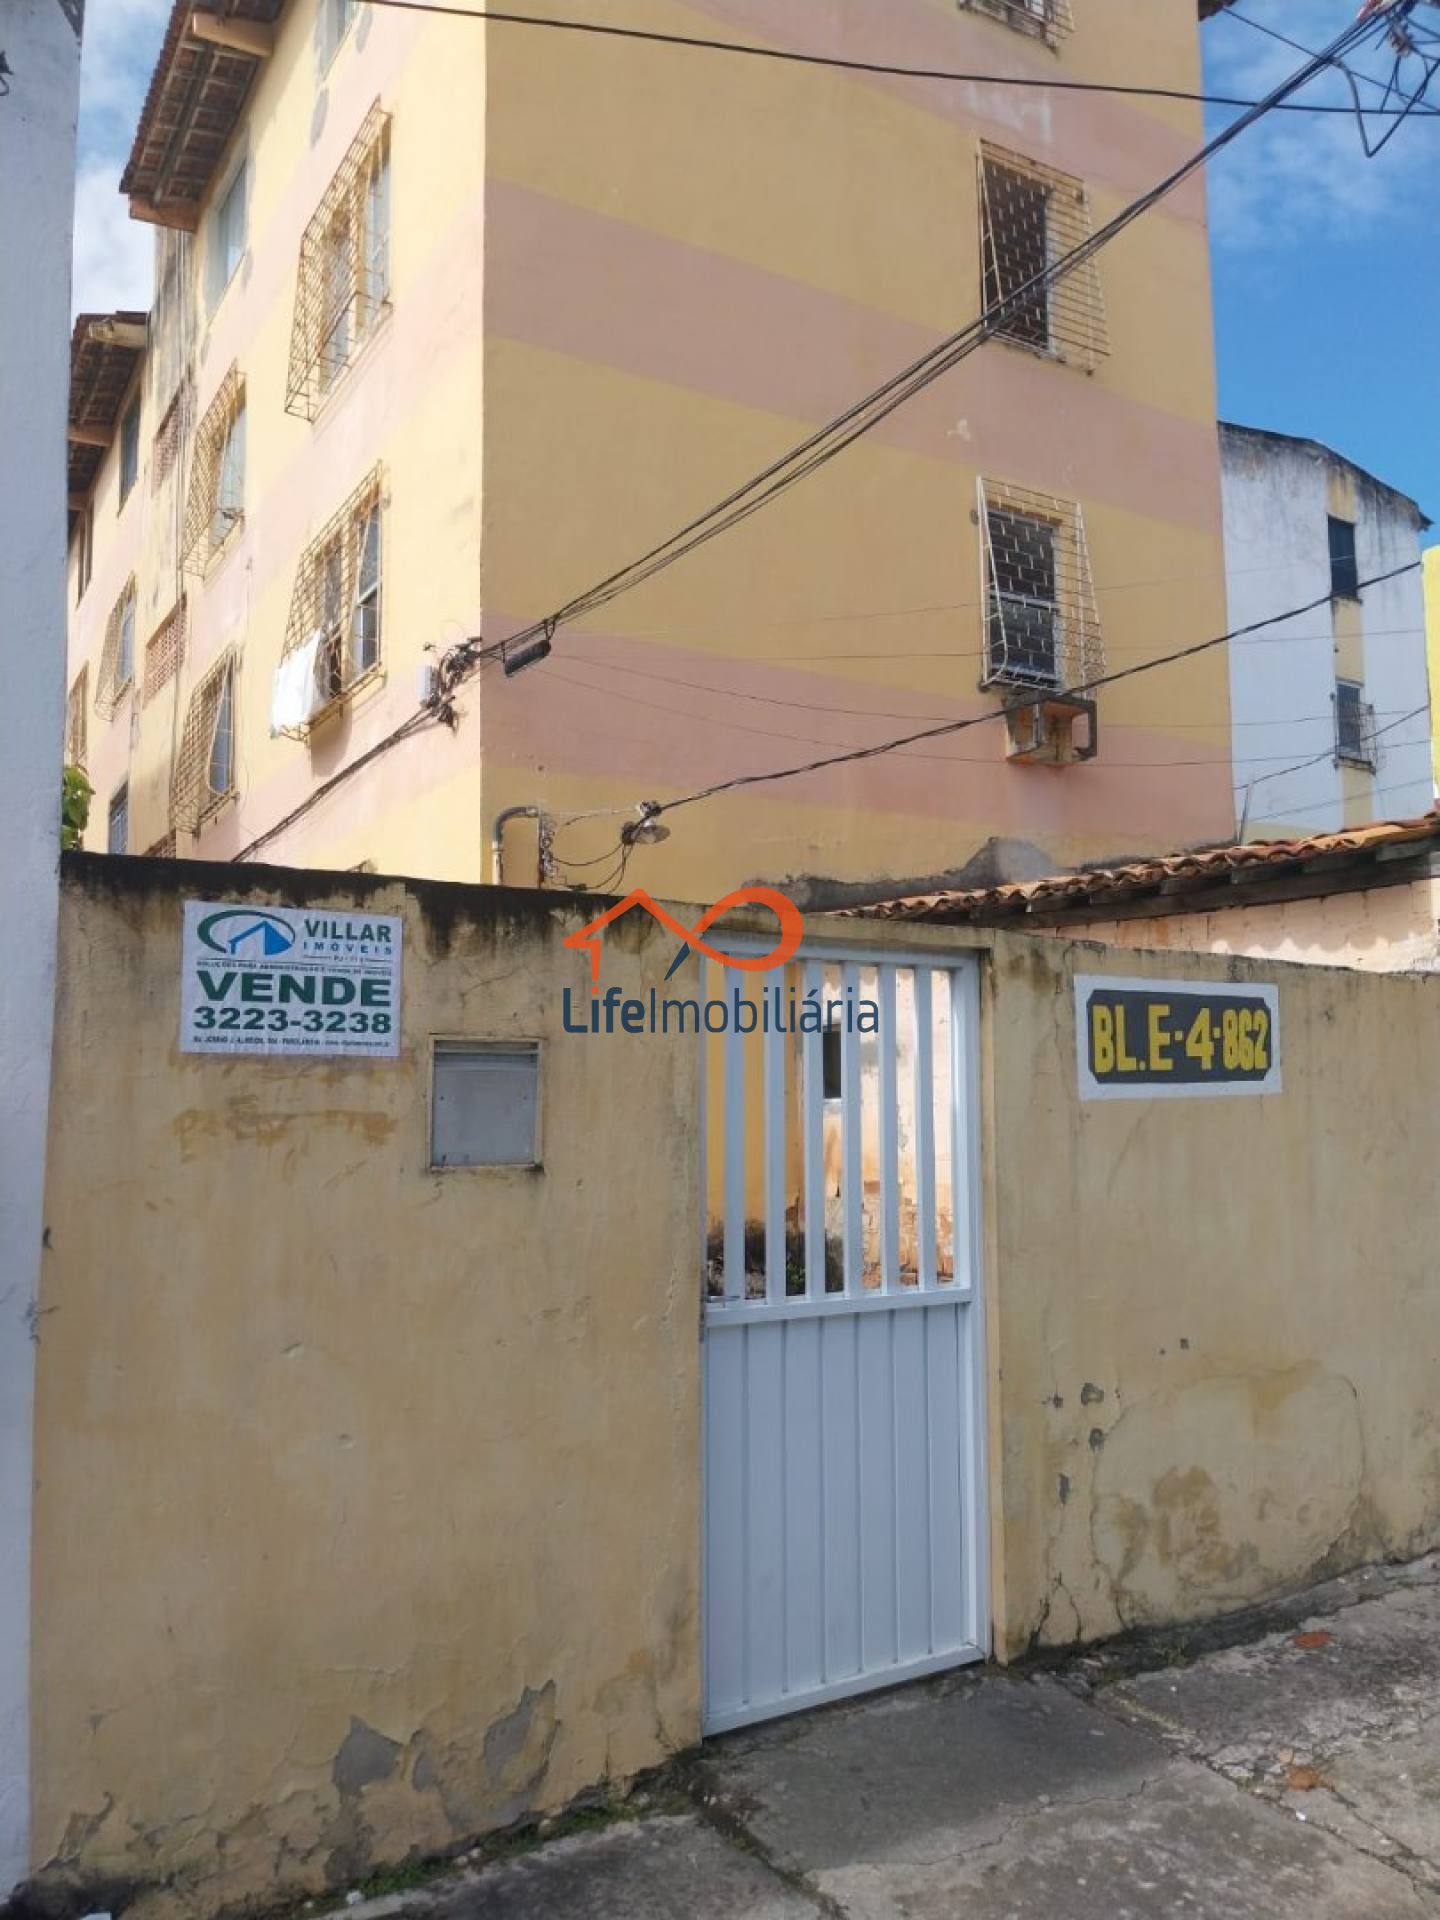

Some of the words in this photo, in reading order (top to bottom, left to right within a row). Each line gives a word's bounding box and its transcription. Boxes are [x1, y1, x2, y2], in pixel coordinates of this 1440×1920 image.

[304, 919, 391, 942] VILLAR
[197, 970, 391, 1007] VENDE
[193, 1006, 391, 1034] 3223-3238
